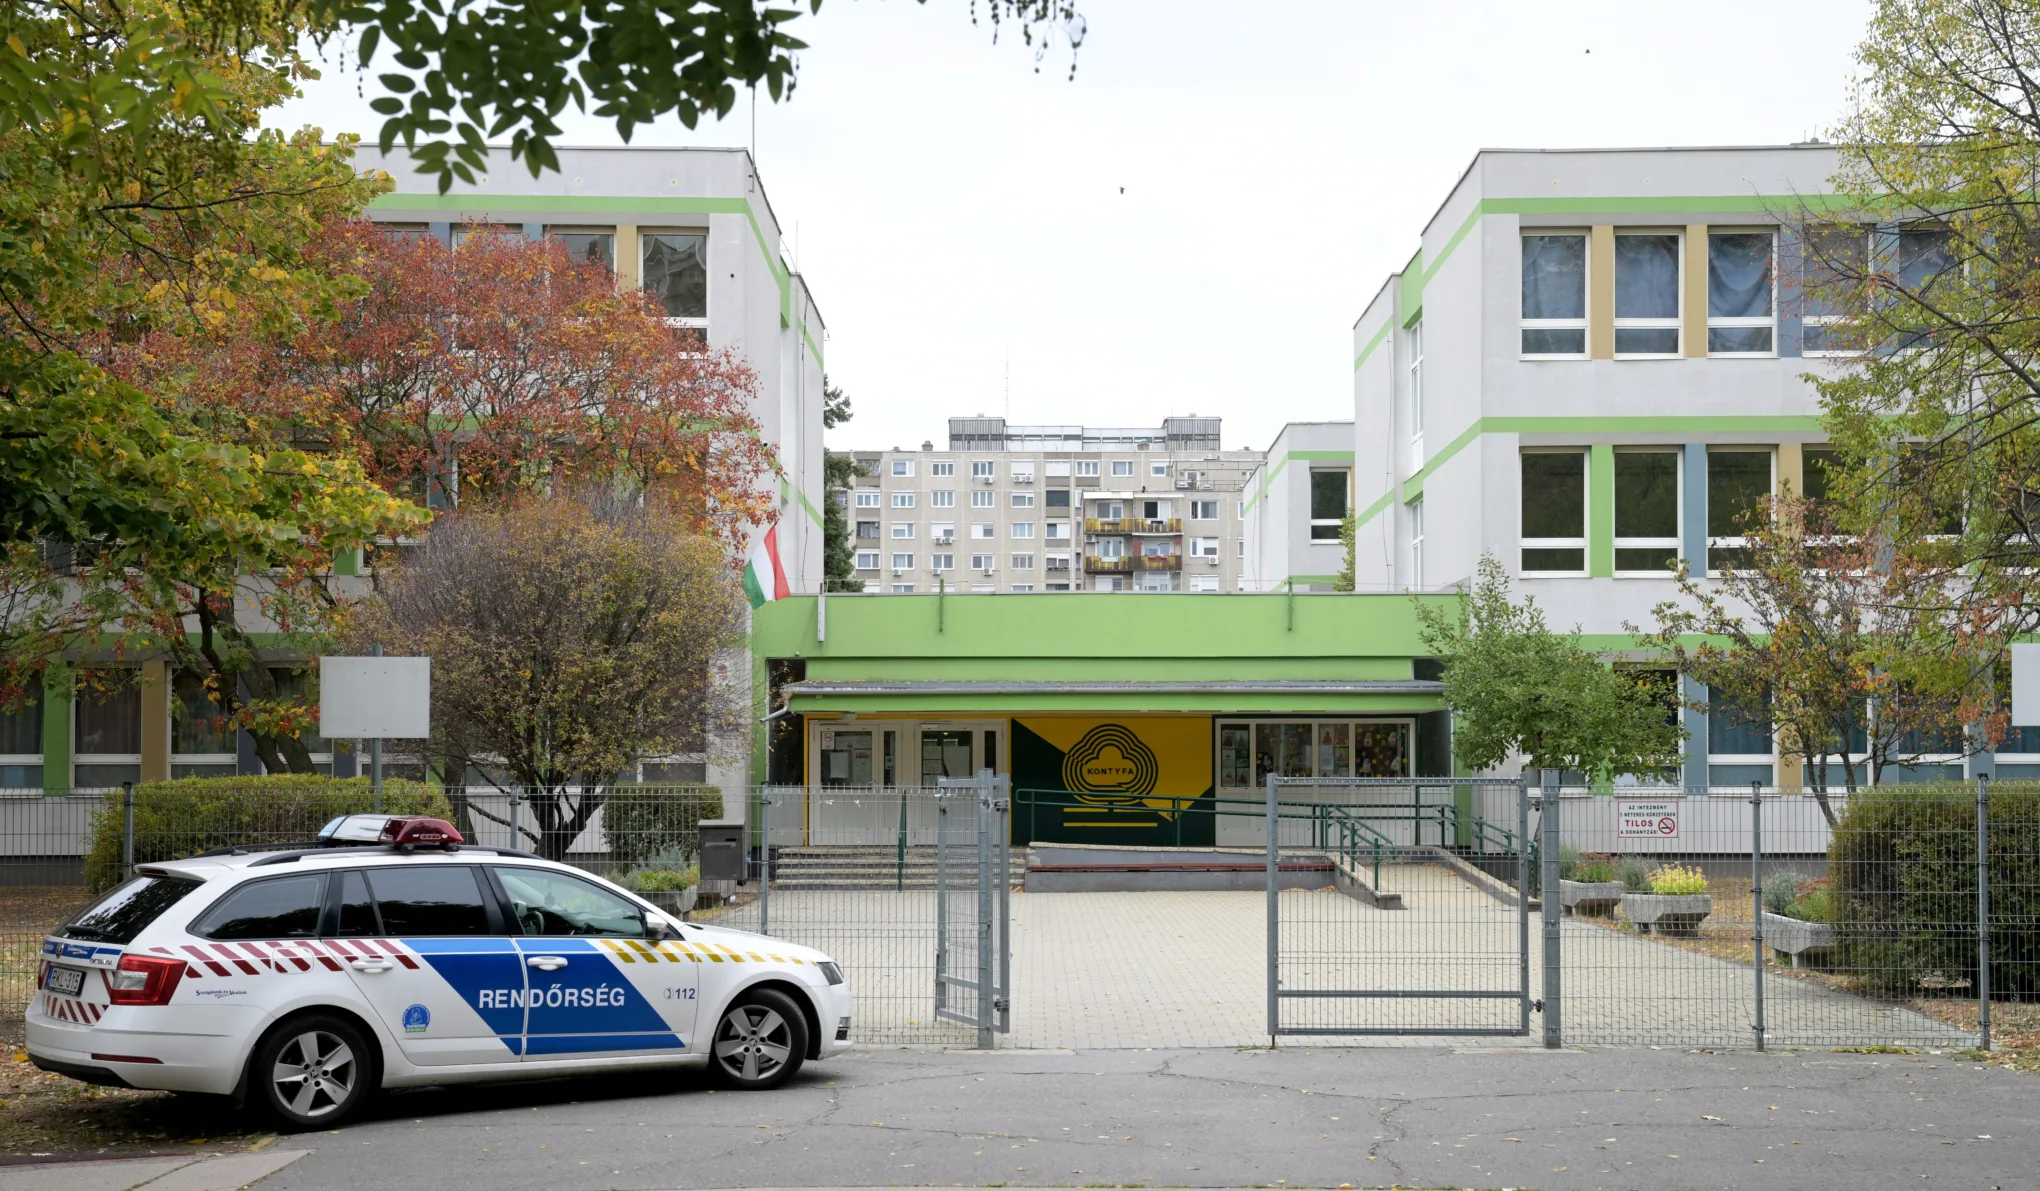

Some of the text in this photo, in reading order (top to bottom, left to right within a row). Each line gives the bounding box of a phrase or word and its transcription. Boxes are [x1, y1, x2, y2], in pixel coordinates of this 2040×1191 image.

[1087, 767, 1134, 775] KONTYFA
[51, 969, 80, 990] RKL-315
[479, 983, 625, 1008] RENDŐRSÉG
[675, 987, 696, 1000] 112
